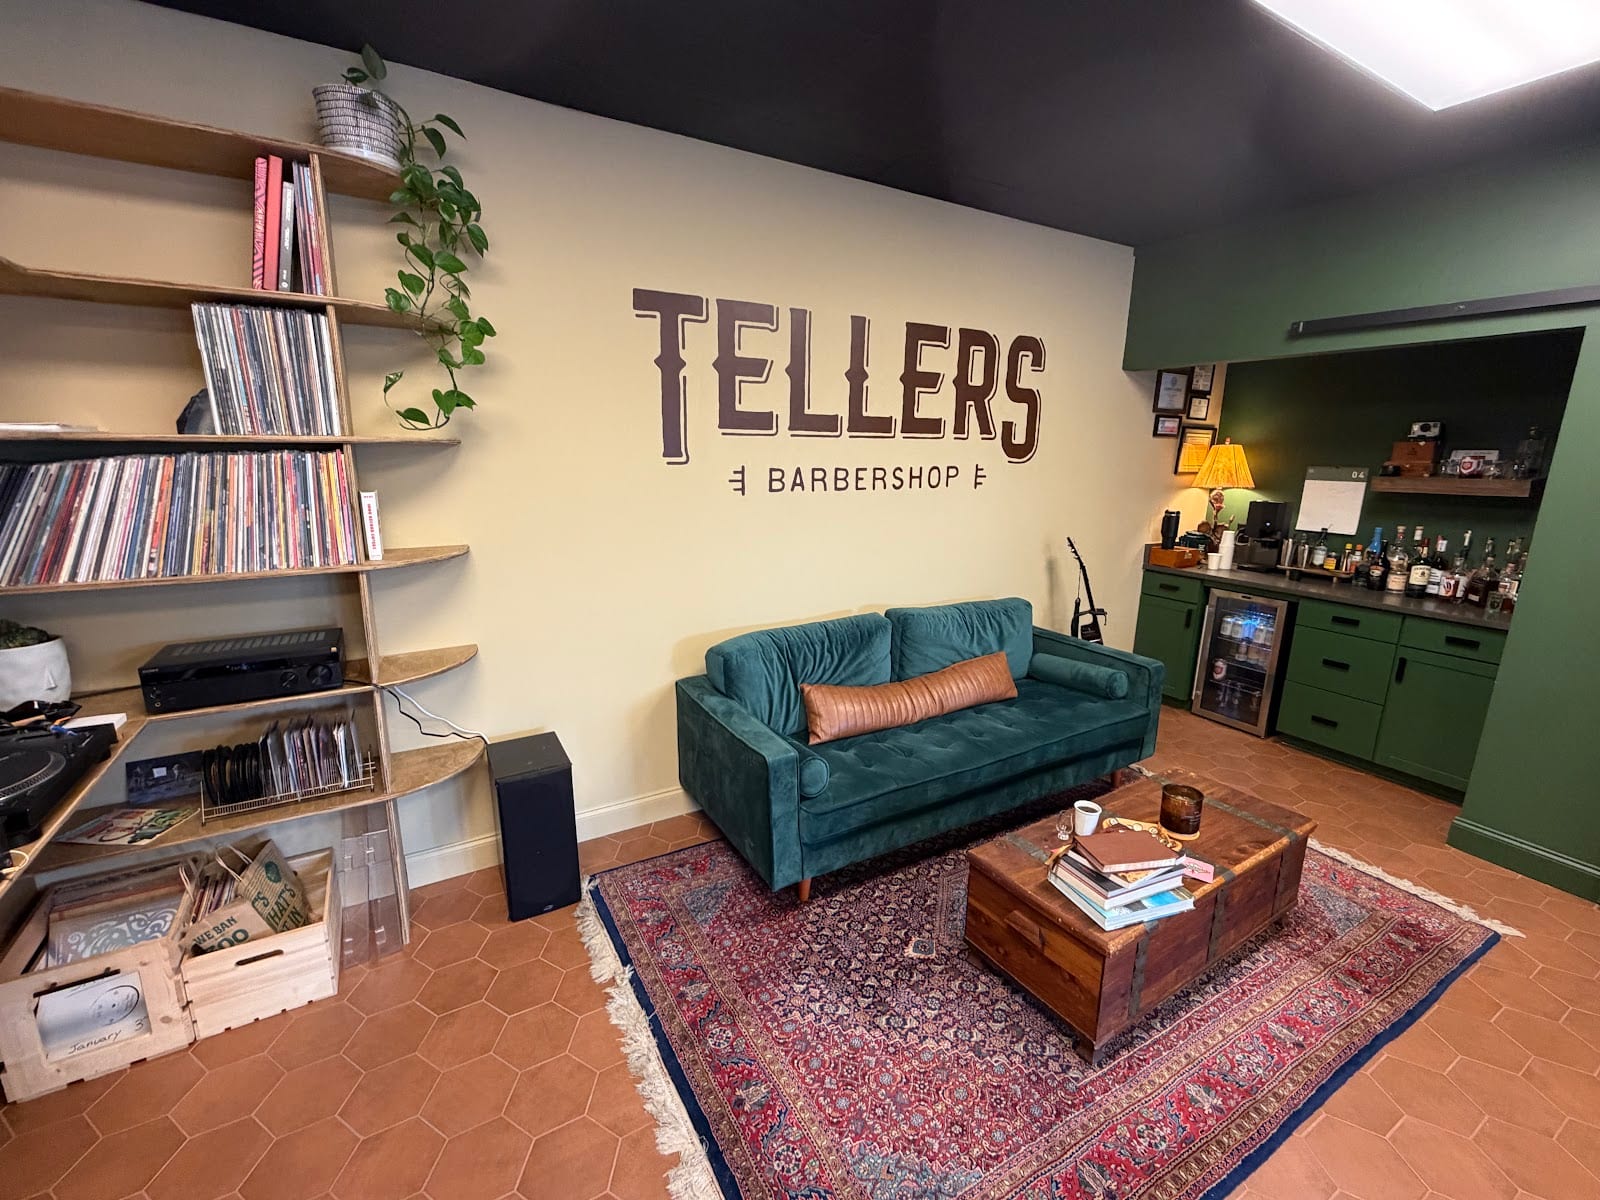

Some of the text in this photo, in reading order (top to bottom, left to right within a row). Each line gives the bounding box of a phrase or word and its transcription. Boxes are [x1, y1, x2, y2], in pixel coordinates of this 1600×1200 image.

[632, 288, 1046, 464] TELLERS
[767, 465, 961, 493] BARBERSHOP
[193, 916, 238, 945] WE BAN
[68, 1029, 123, 1055] January
